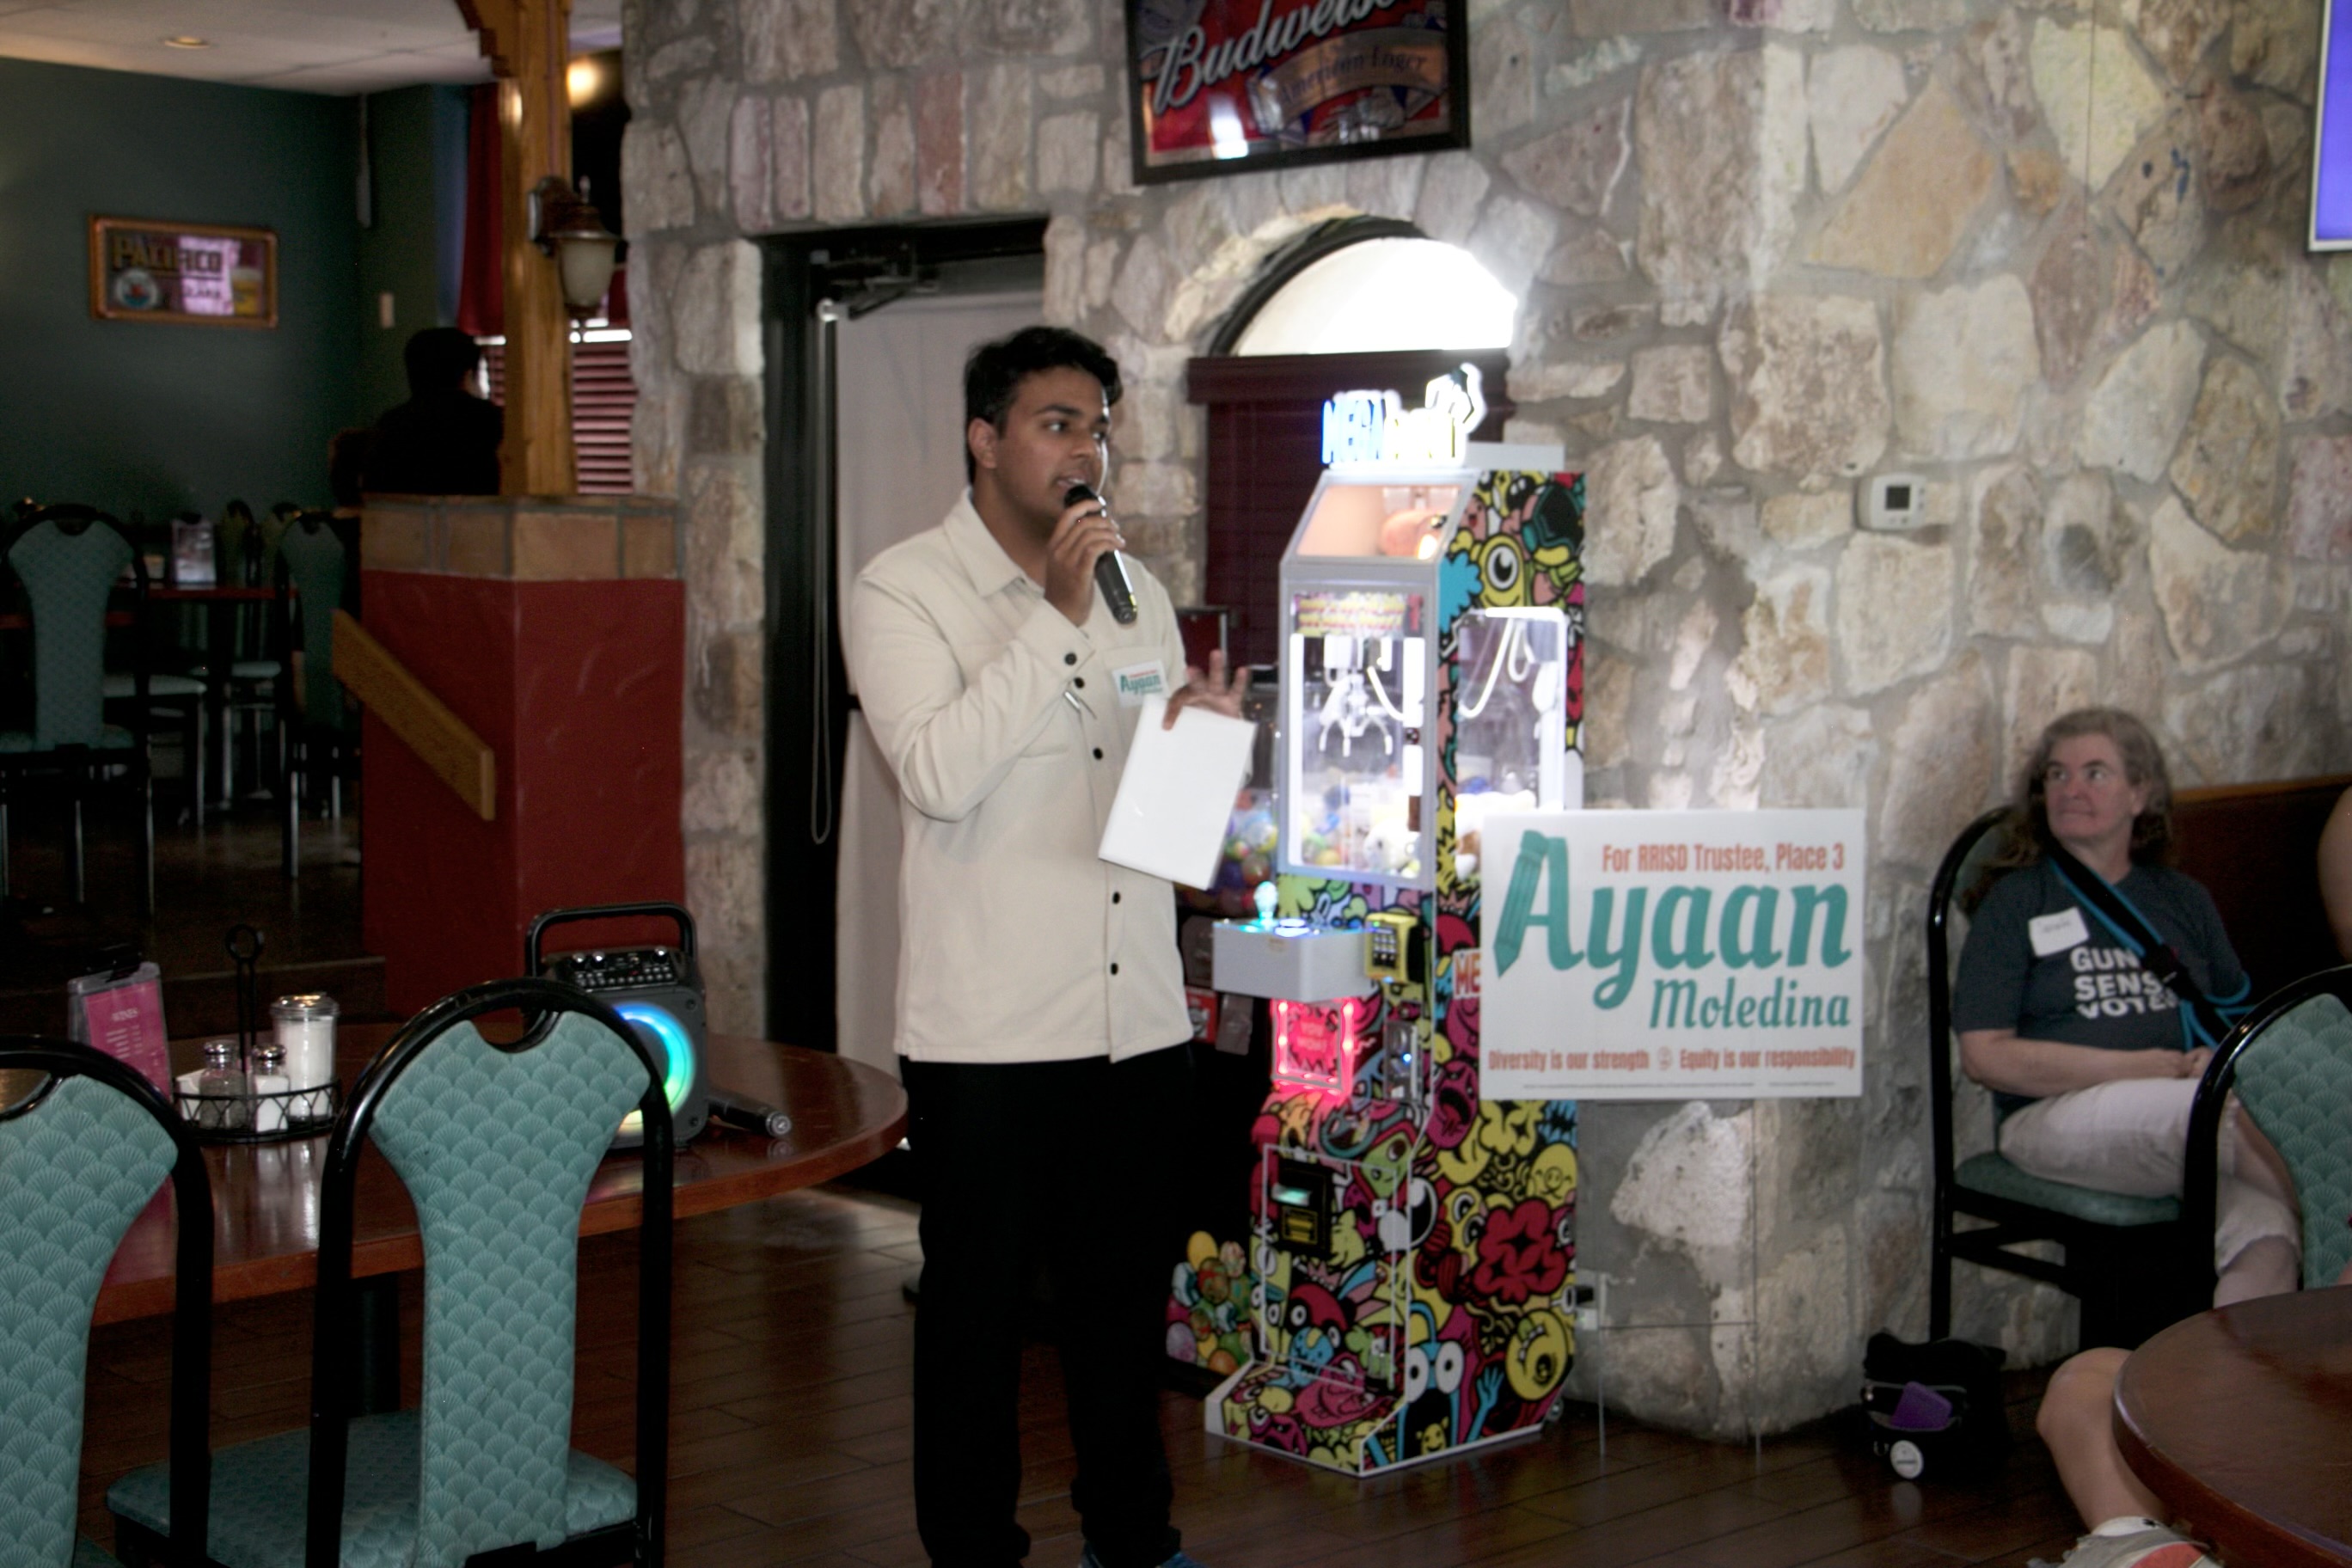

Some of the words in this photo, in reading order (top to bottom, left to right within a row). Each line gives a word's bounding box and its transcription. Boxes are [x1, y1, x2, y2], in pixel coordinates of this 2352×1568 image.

[1602, 844, 1632, 873] For
[1638, 843, 1687, 873] RRISD
[1694, 842, 1771, 873] Trustee,
[1775, 842, 1828, 871] Place
[1832, 842, 1845, 870] 3
[1493, 830, 1853, 1010] Ayaan
[2070, 947, 2140, 972] GUN
[2073, 971, 2164, 1001] SENS
[1650, 977, 1851, 1029] Moledina
[1488, 1049, 1546, 1073] Diversity
[1550, 1049, 1563, 1069] is
[1565, 1051, 1588, 1069] our
[1592, 1049, 1650, 1071] strength
[1680, 1048, 1719, 1071] Equity
[1723, 1048, 1736, 1068] is
[1739, 1050, 1761, 1068] our
[1764, 1045, 1855, 1069] responsibility
